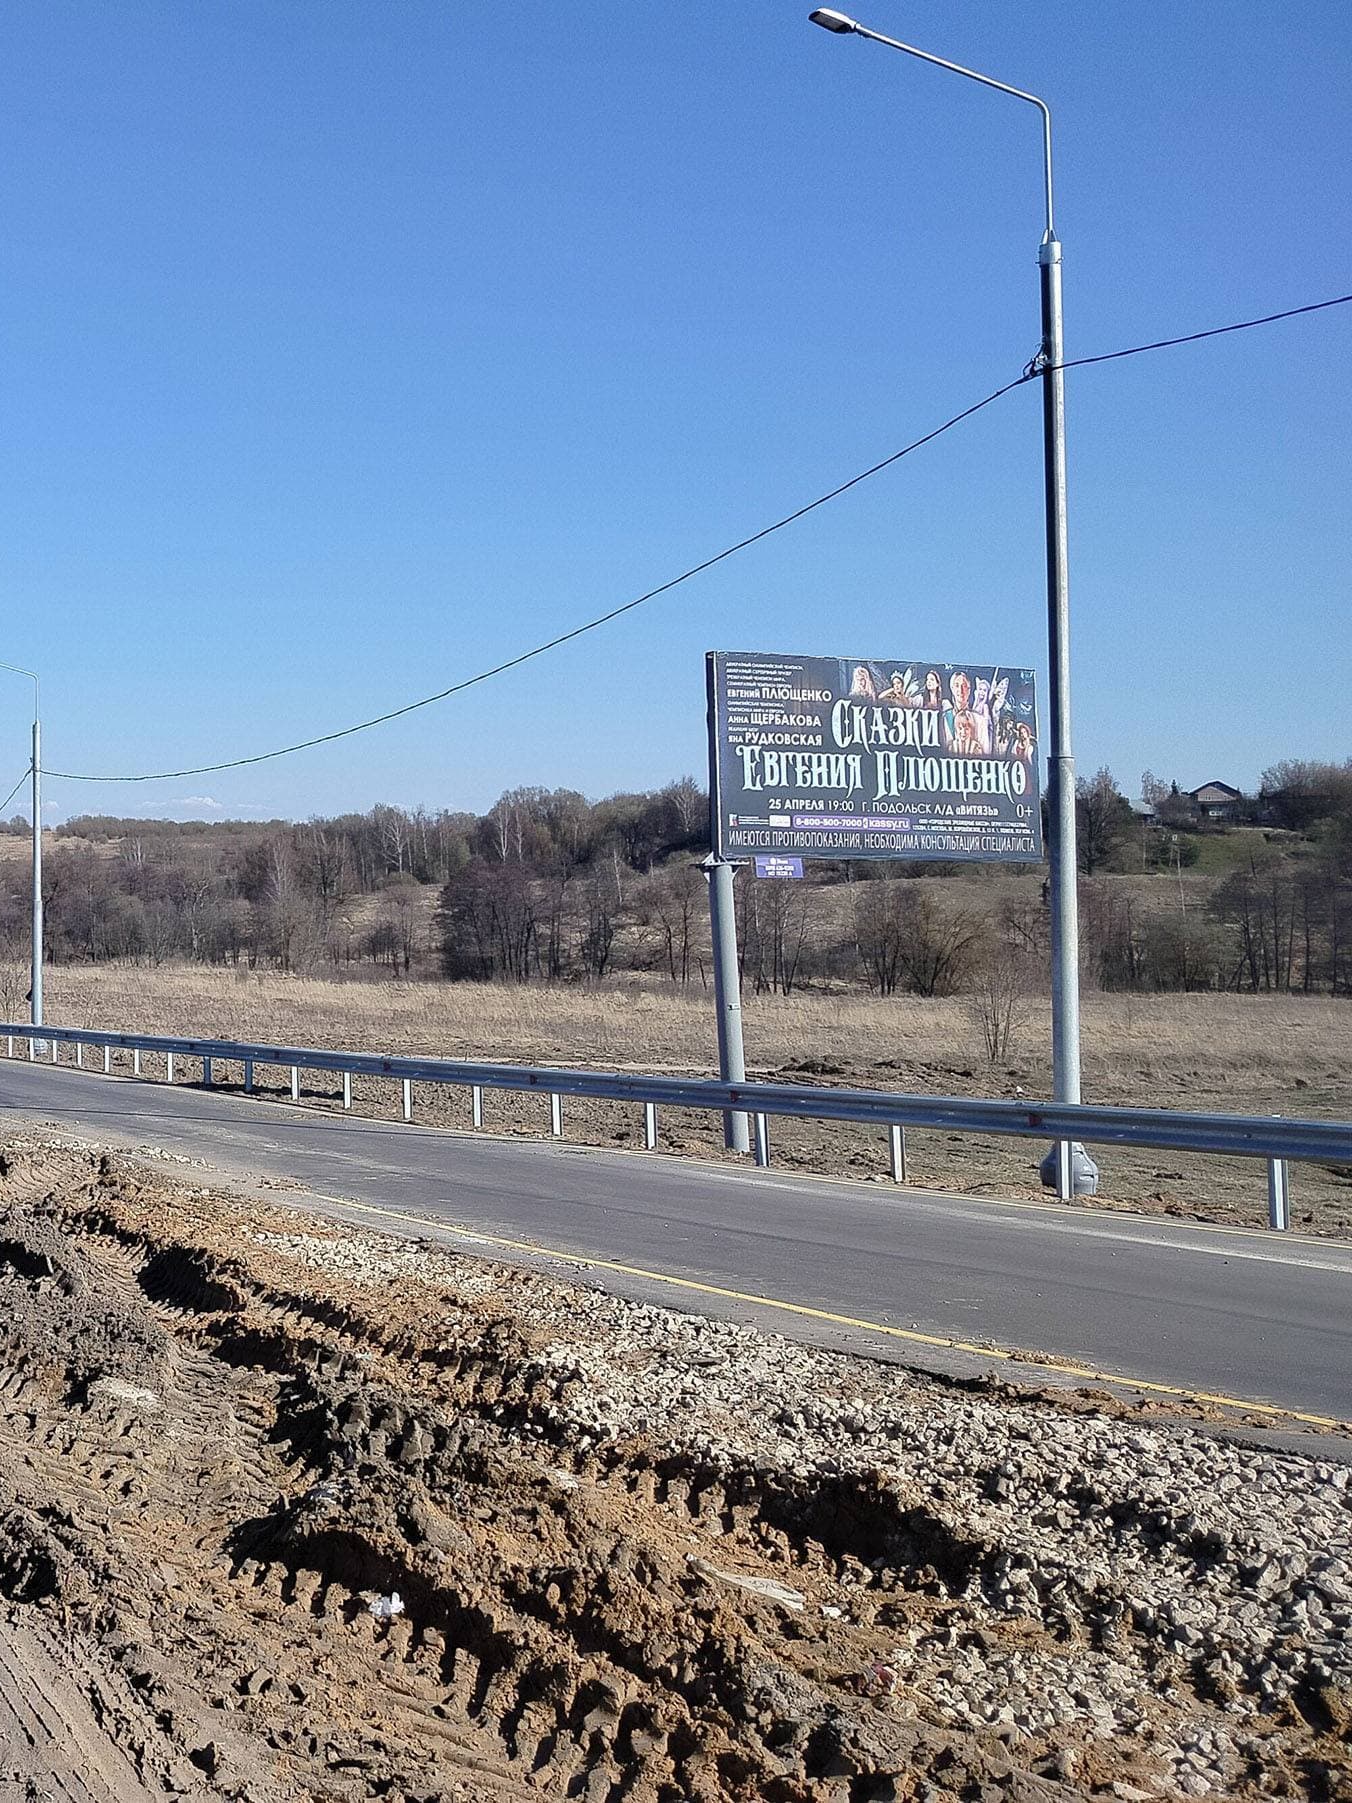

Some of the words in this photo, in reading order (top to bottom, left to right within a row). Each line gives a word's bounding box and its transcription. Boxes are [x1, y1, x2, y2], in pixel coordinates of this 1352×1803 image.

[762, 688, 832, 702] ПЛЮЩЕНКО
[728, 715, 749, 724] АННА
[750, 713, 822, 727] ЩЕРБАКОВА
[728, 735, 744, 743] ЯНА
[745, 732, 822, 746] РУДКОВСКАЯ
[768, 798, 781, 810] 25
[784, 799, 825, 811] АПРЕЛЯ
[828, 801, 854, 812] 19:00
[873, 802, 932, 814] ПОДОЛЬСК
[934, 804, 954, 816] Л/Д
[956, 805, 999, 816] «ВИТЯЗЬ»
[1016, 803, 1034, 818] 0+
[869, 818, 909, 830] kassy.ru
[729, 831, 770, 846] ИМЕЮТСЯ
[772, 831, 863, 850] ПРОТИВОПОКАЗАНИЯ,
[864, 834, 919, 851] НЕОБХОДИМА
[921, 835, 980, 853] КОНСУЛЬТАЦИЯ
[981, 836, 1035, 854] СПЕЦИАЛИСТА
